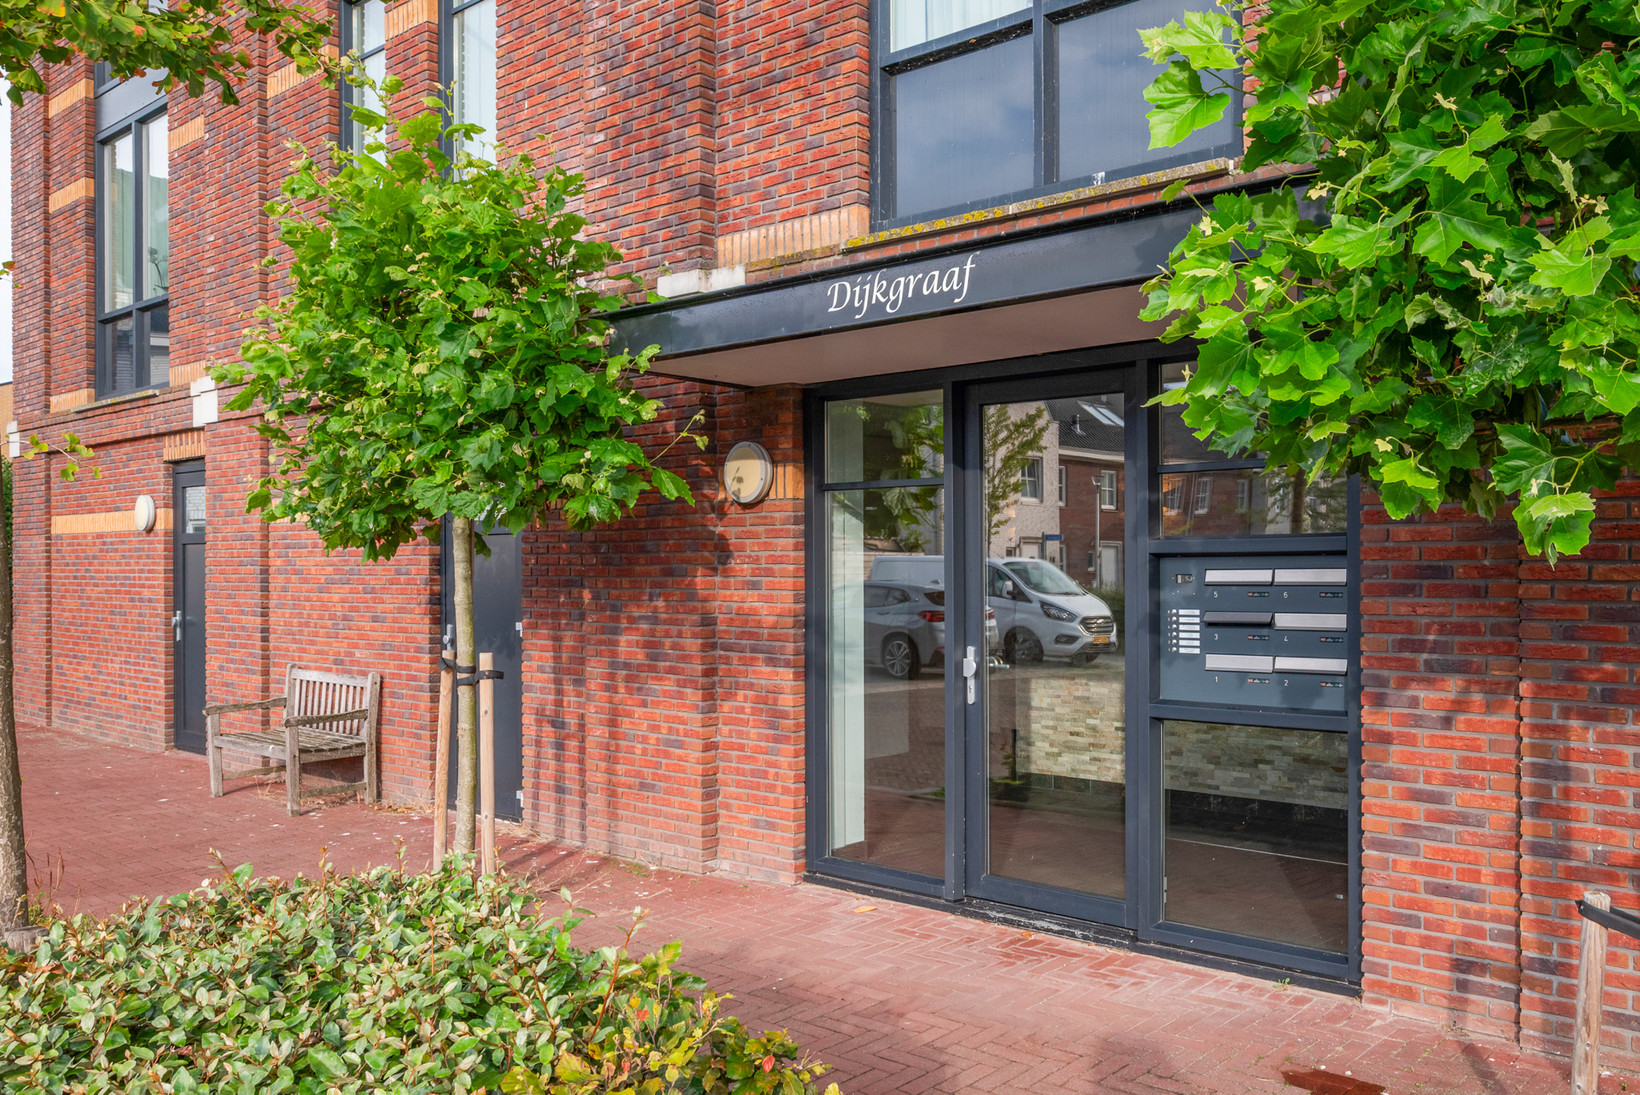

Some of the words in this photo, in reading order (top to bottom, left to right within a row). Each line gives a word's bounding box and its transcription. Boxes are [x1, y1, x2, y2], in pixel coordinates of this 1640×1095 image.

[827, 251, 981, 319] Dijkgraaf
[1213, 590, 1219, 598] 5
[1282, 591, 1289, 599] 6
[1213, 633, 1219, 641] 3
[1283, 679, 1289, 687] 2
